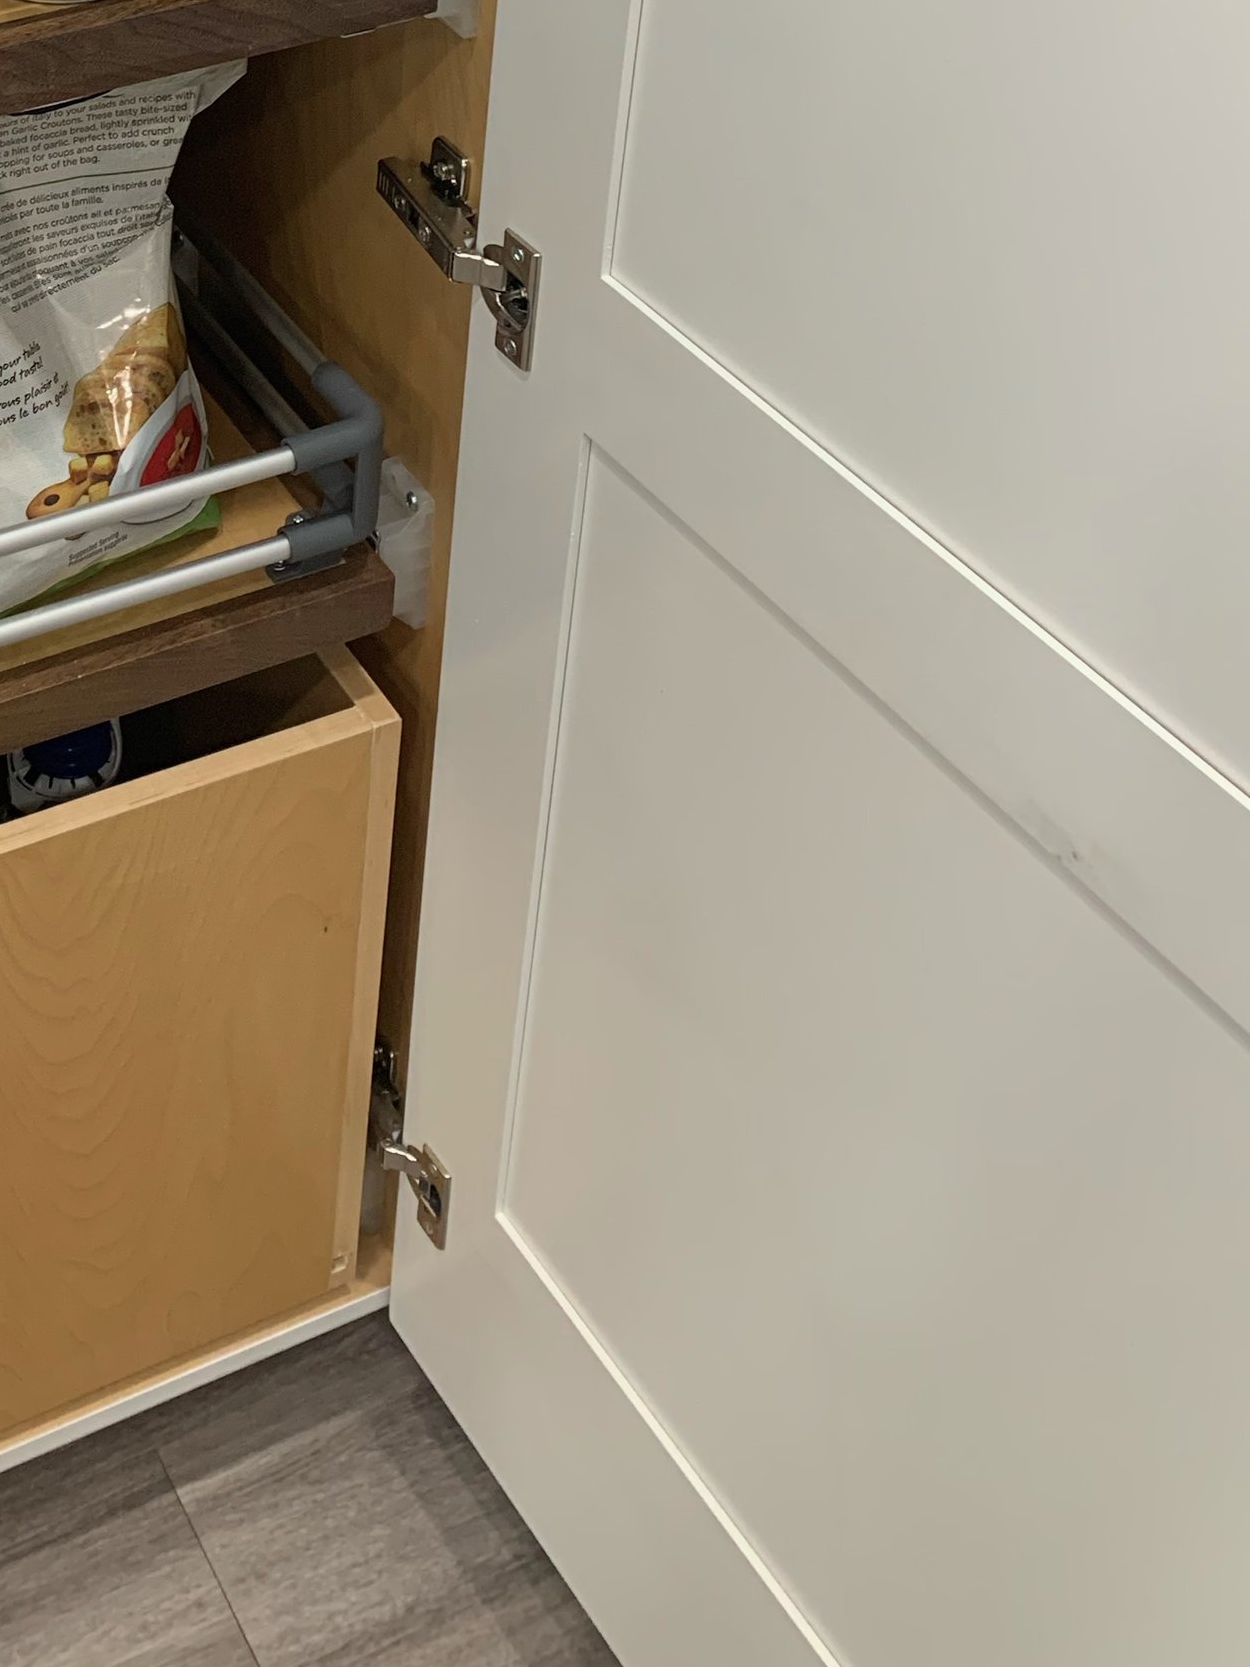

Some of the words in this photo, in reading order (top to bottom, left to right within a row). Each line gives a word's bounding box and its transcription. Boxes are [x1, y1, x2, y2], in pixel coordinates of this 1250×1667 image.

[65, 105, 86, 118] your
[88, 99, 117, 112] salads
[138, 92, 174, 105] recipes
[11, 123, 39, 136] Garlic
[40, 115, 84, 131] Croutons.
[86, 110, 113, 122] These
[114, 105, 140, 118] tasty
[140, 101, 189, 116] bite-sized
[0, 133, 29, 149] baked
[100, 117, 130, 131] lightly
[130, 113, 176, 128] sprinkled
[72, 132, 107, 145] Perfect
[141, 125, 176, 137] crunch
[48, 147, 75, 161] soups
[95, 138, 149, 153] casseroles,
[8, 165, 32, 180] right
[62, 156, 78, 168] the
[79, 154, 102, 167] bag.
[29, 190, 70, 205] délicieux
[70, 184, 111, 198] aliments
[111, 179, 149, 193] inspirés
[36, 201, 61, 215] toute
[71, 194, 104, 207] famille.
[45, 226, 80, 241] saveurs
[80, 218, 119, 233] exquises
[50, 213, 89, 229] croûtons
[59, 232, 96, 248] focaccia
[22, 340, 41, 361] table
[23, 378, 53, 405] plaisir
[18, 406, 30, 420] le
[31, 398, 54, 415] bon
